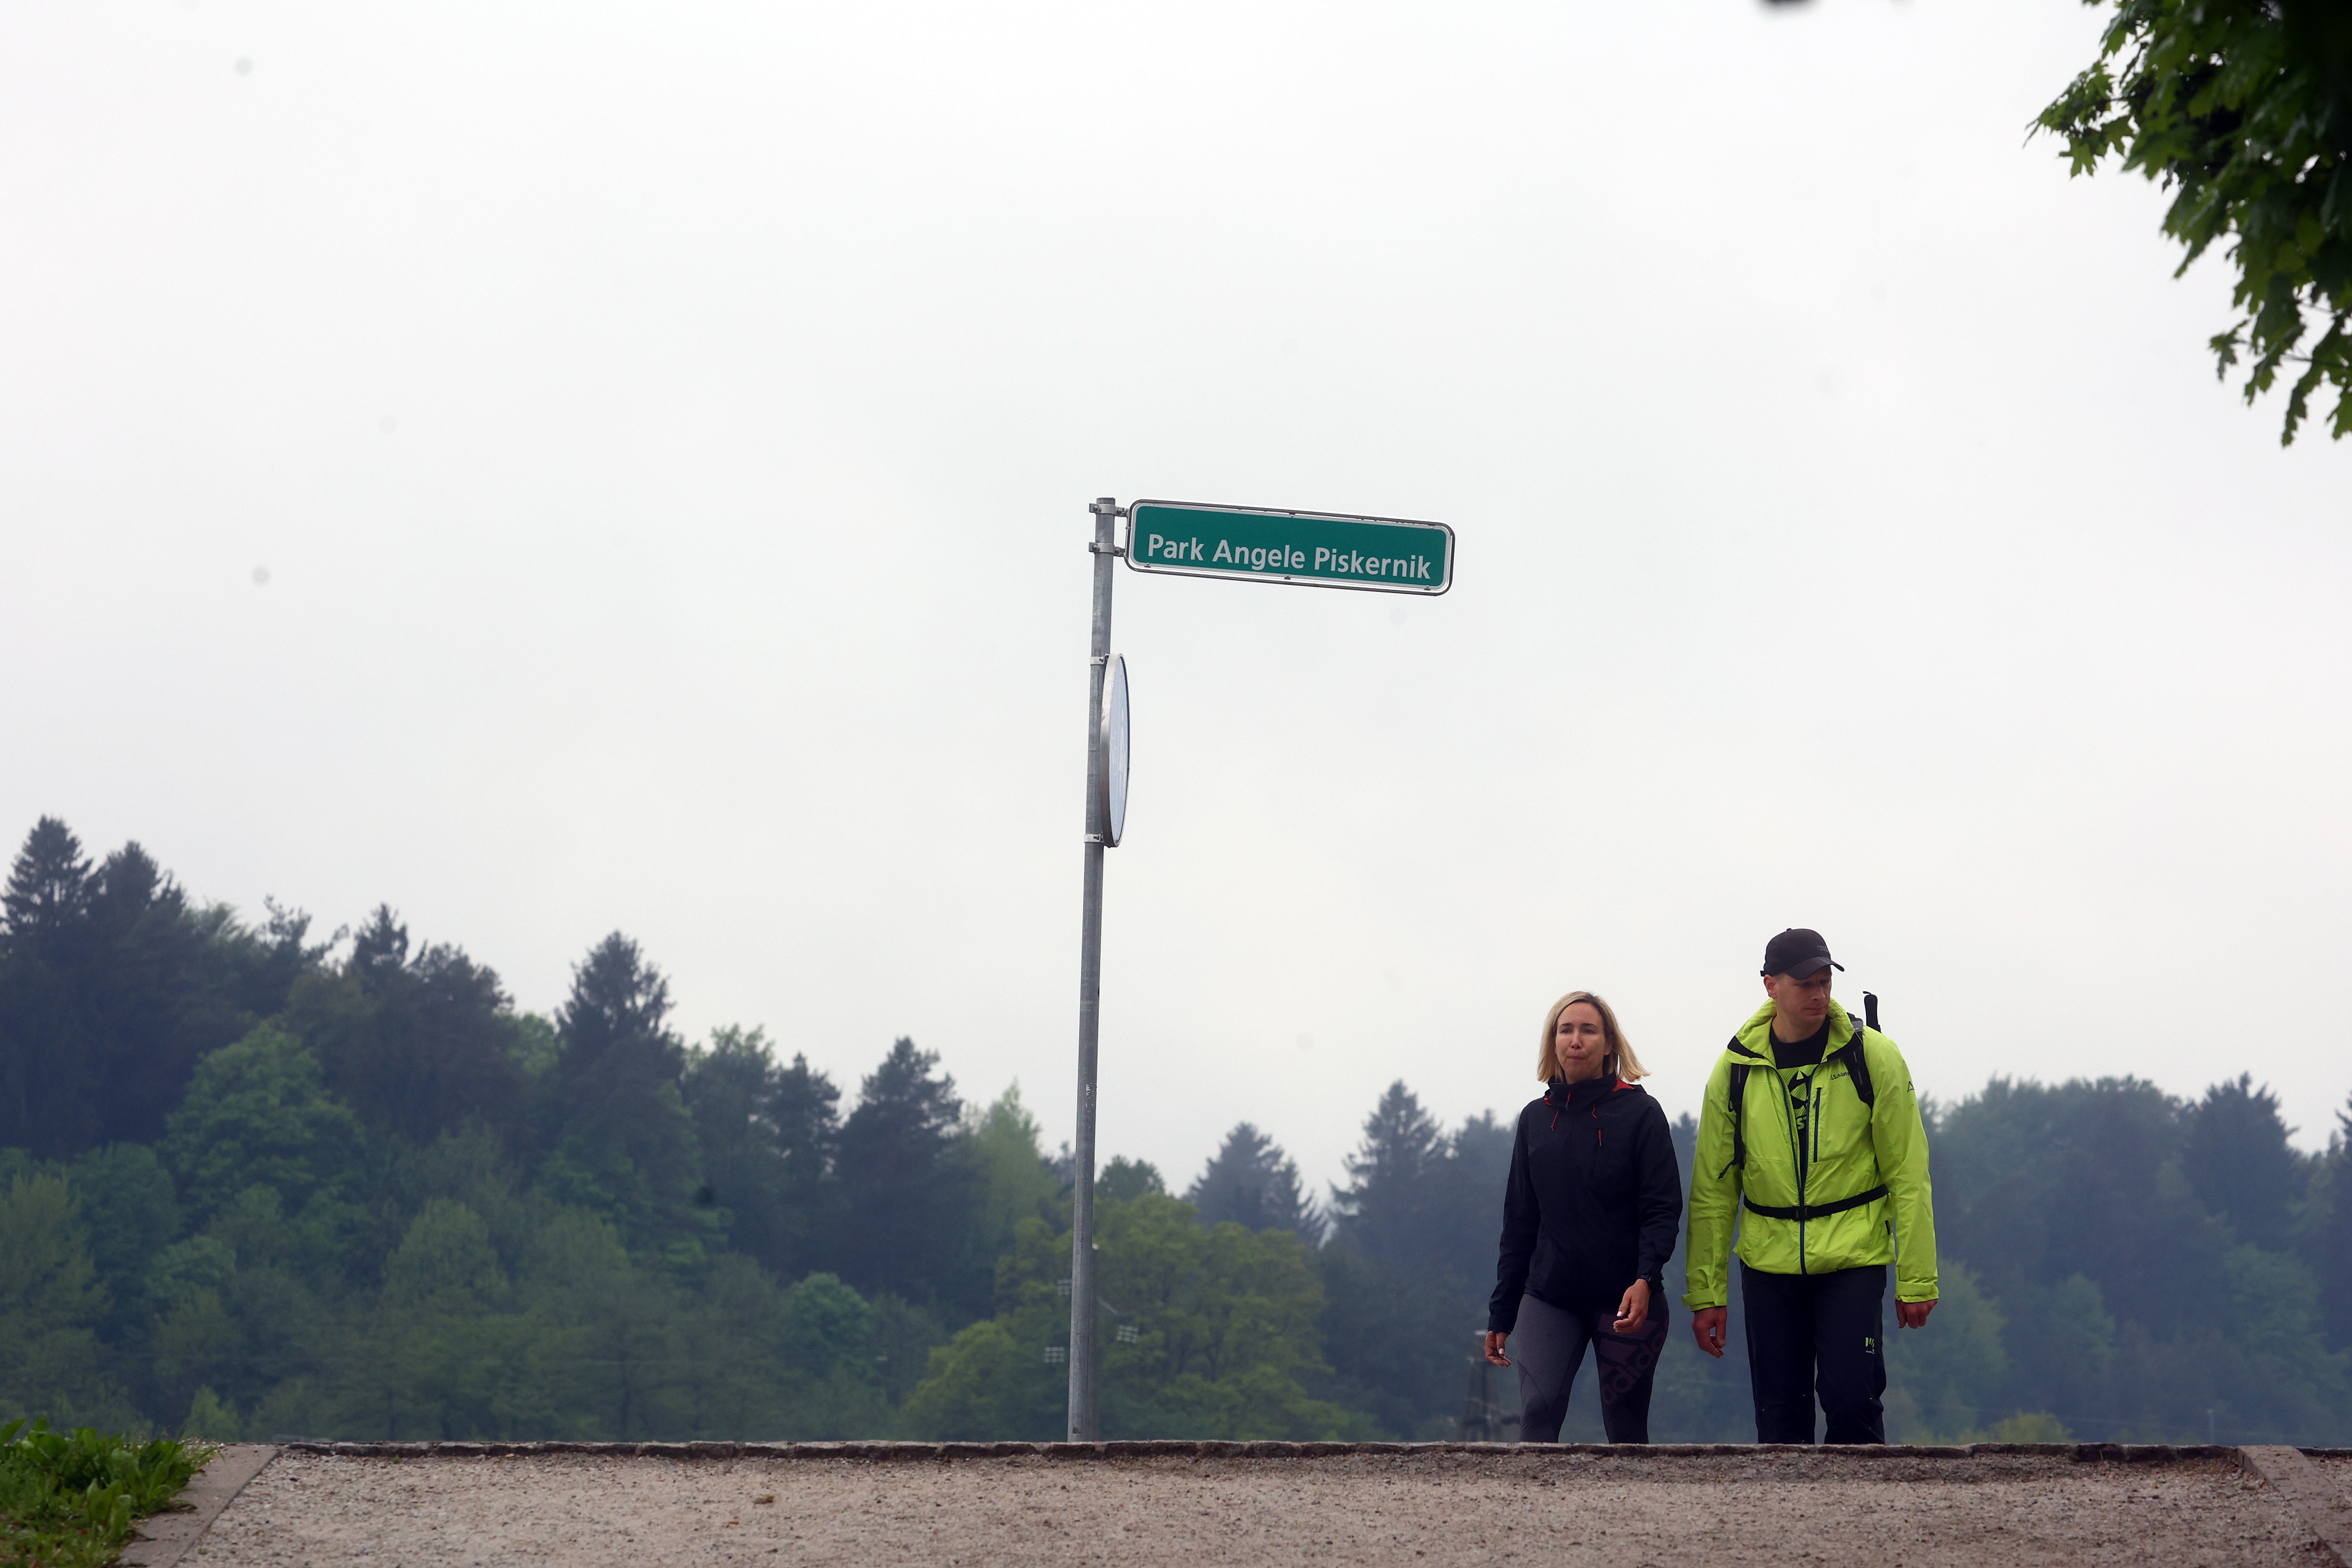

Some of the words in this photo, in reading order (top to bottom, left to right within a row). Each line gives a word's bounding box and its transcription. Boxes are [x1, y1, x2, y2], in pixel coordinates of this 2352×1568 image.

[1149, 534, 1203, 560] Park
[1212, 540, 1305, 570] Angele
[1315, 548, 1430, 578] Piskernik
